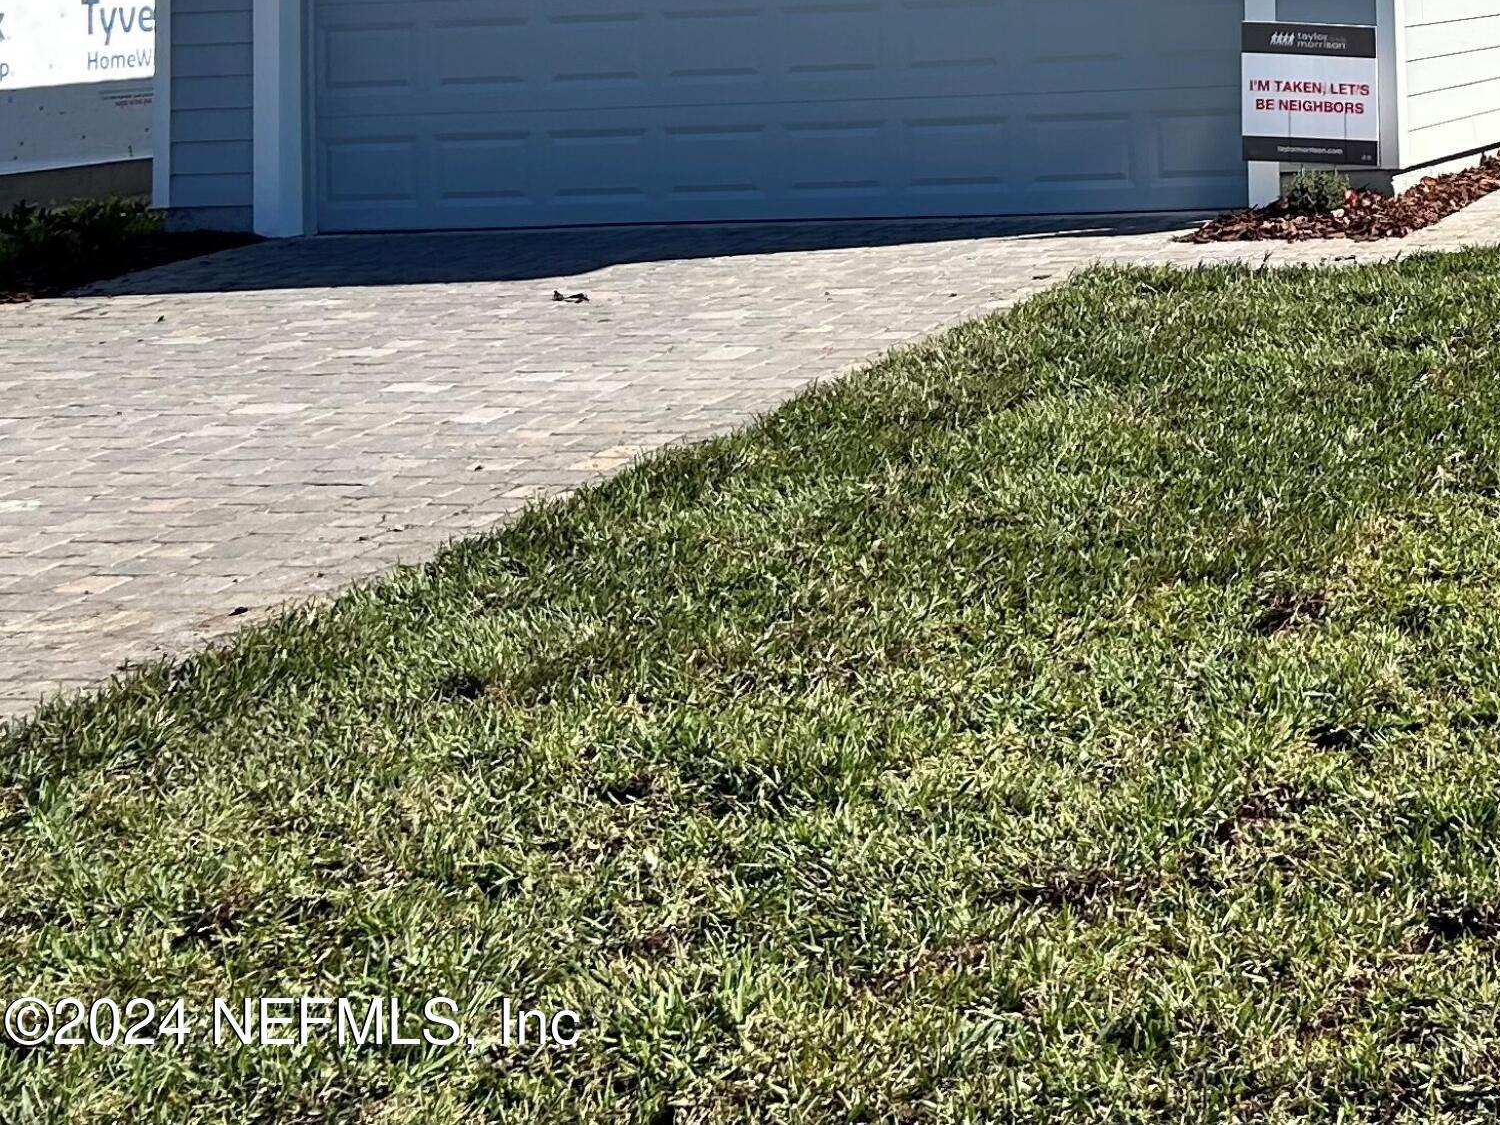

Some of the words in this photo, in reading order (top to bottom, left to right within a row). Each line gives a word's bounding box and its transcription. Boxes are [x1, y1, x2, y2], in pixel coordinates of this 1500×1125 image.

[1249, 79, 1270, 92] I'M
[1274, 80, 1326, 96] TAKEN,
[1330, 83, 1370, 96] LET'S
[1255, 98, 1275, 111] BE
[1278, 98, 1364, 115] NEIGHBORS
